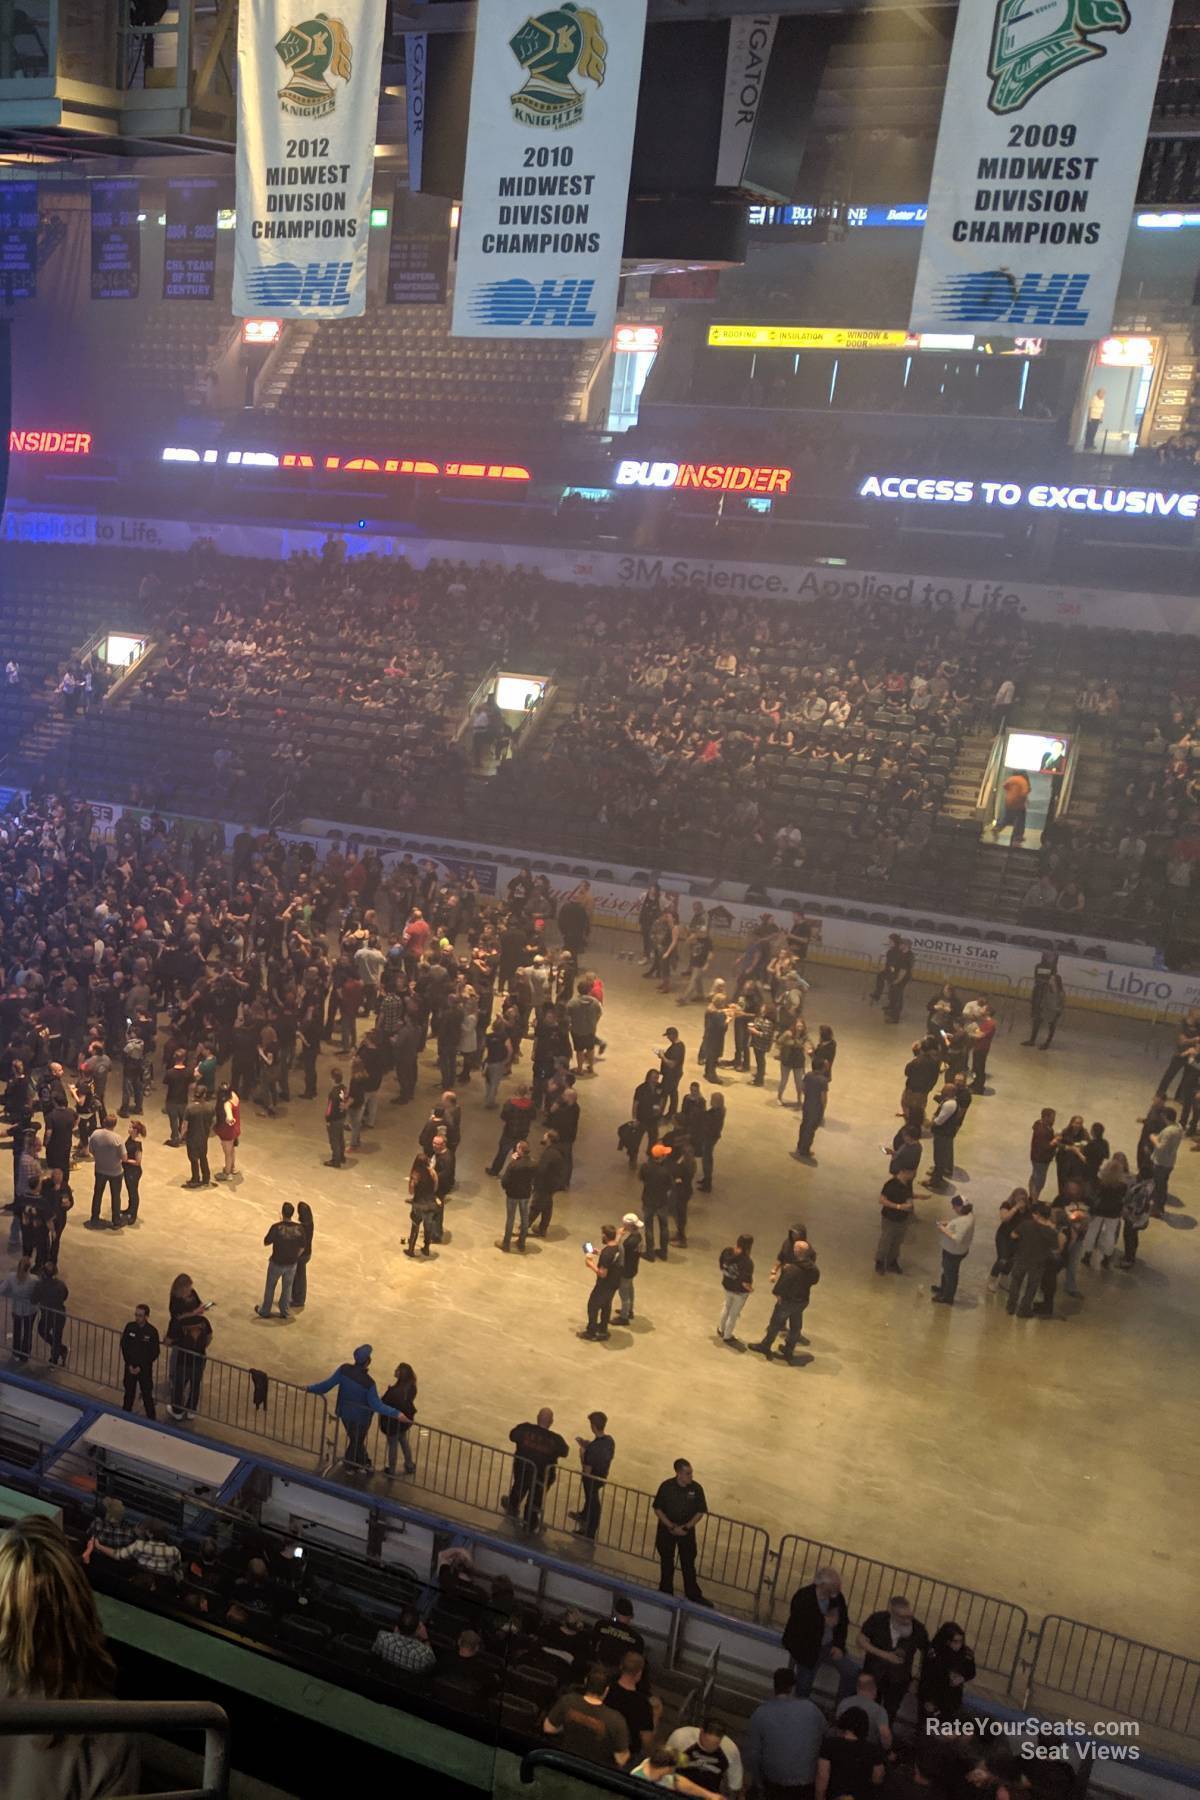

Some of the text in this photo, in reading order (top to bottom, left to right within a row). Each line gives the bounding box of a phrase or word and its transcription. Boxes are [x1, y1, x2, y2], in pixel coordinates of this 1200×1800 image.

[735, 15, 771, 127] IGATOR
[413, 33, 425, 136] IGATOR
[281, 99, 336, 118] KNIGHTS
[513, 106, 583, 126] KNIGHTS
[1007, 124, 1077, 148] 2009
[286, 137, 330, 158] 2012
[523, 146, 574, 168] 2010
[266, 164, 350, 186] MIDWEST
[977, 157, 1098, 180] MIDWEST
[499, 175, 596, 197] MIDWEST
[266, 191, 346, 213] DIVISION
[974, 189, 1088, 213] DIVISION
[499, 204, 589, 226] DIVISION
[252, 218, 357, 239] CHAMPIONS
[952, 220, 1101, 245] CHAMPIONS
[482, 232, 601, 254] CHAMPIONS
[246, 261, 353, 307] OHL
[467, 278, 597, 327] OHL
[931, 270, 1090, 327] OHL
[722, 331, 758, 339] ROOFING
[779, 332, 824, 341] INSULATION
[847, 331, 881, 341] WINDOW
[846, 340, 868, 349] DOOR
[9, 430, 93, 454] NSIDER
[860, 475, 1200, 518] ACCESS TO EXCLUSIVE
[94, 521, 114, 540] to
[617, 557, 1028, 613] 3M Science. Applied to Life.
[913, 938, 999, 960] NORTH STAR
[1106, 969, 1173, 999] Libro
